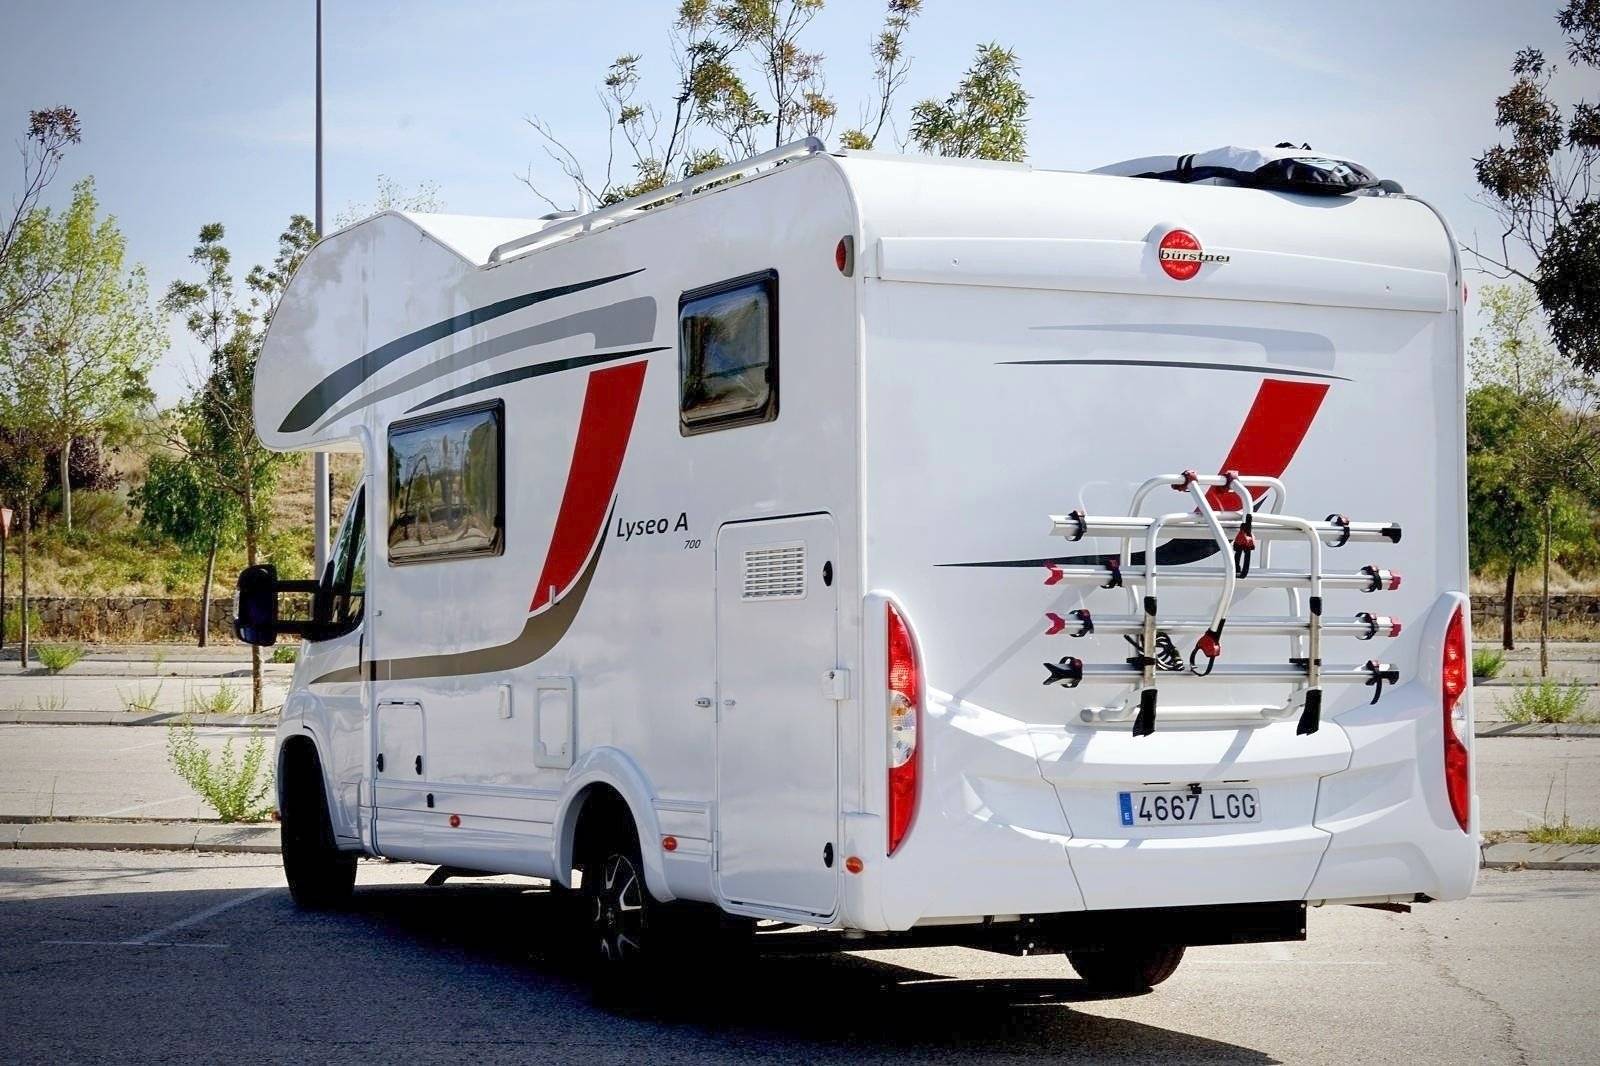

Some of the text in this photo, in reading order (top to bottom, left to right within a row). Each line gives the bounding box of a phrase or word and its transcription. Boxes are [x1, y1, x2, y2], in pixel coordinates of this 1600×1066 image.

[616, 512, 688, 541] Lyseo A
[684, 539, 701, 550] 700
[1139, 794, 1255, 821] 4667 LGG
